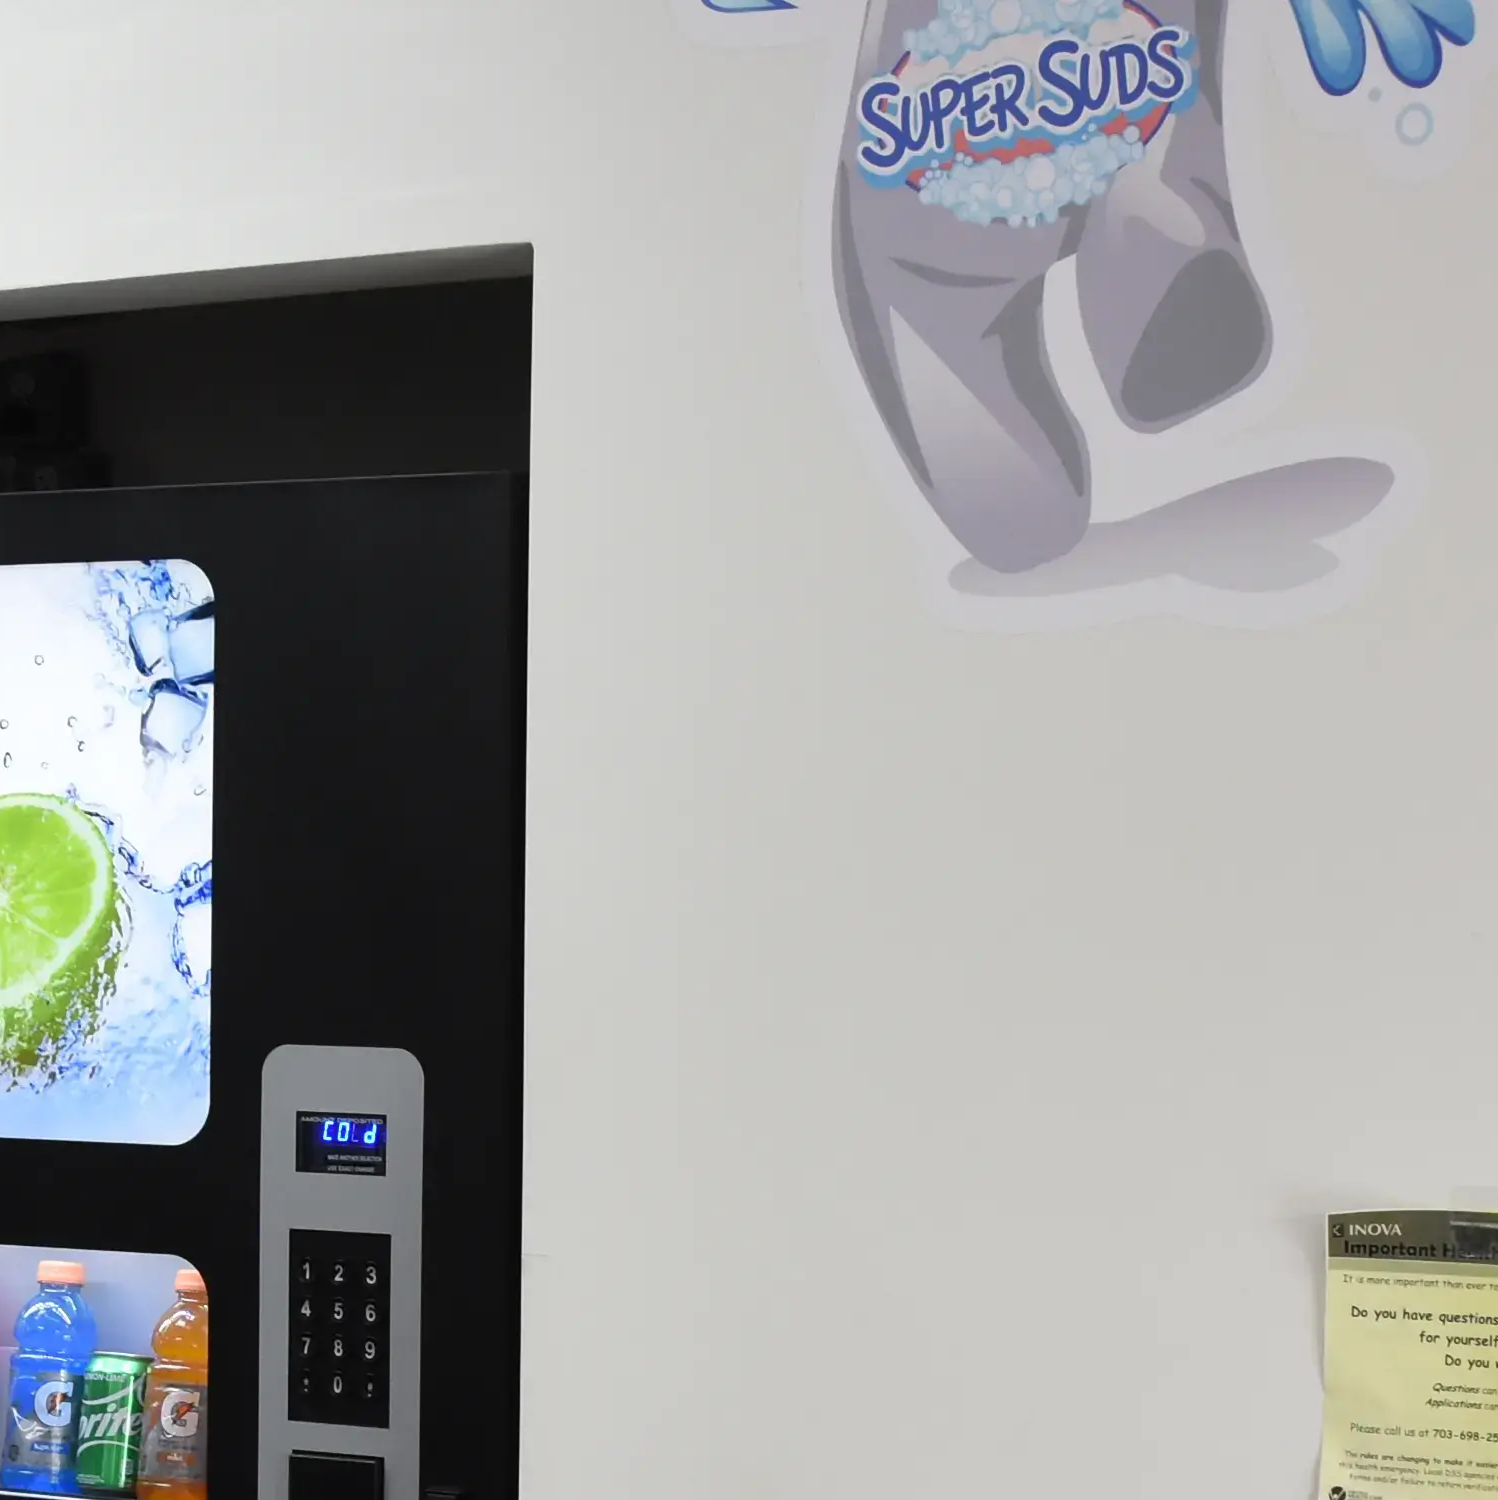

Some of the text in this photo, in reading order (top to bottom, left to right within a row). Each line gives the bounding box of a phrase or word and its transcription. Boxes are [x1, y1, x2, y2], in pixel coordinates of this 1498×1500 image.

[1349, 1222, 1402, 1237] INOVA
[1344, 1240, 1437, 1261] Important
[302, 1261, 377, 1285] 1 2 3
[300, 1299, 377, 1322] 4 5 6
[1351, 1305, 1369, 1318] Do
[1374, 1308, 1398, 1322] you
[1403, 1308, 1434, 1322] have
[1419, 1330, 1441, 1344] for
[300, 1337, 376, 1360] 7 8 9
[1444, 1354, 1462, 1369] Do
[1467, 1358, 1490, 1371] you
[333, 1375, 343, 1394] 0
[33, 1380, 75, 1427] G
[160, 1389, 201, 1437] G
[1350, 1422, 1381, 1435] Please
[1384, 1426, 1402, 1437] call
[1404, 1428, 1416, 1437] us
[1418, 1429, 1430, 1438] at
